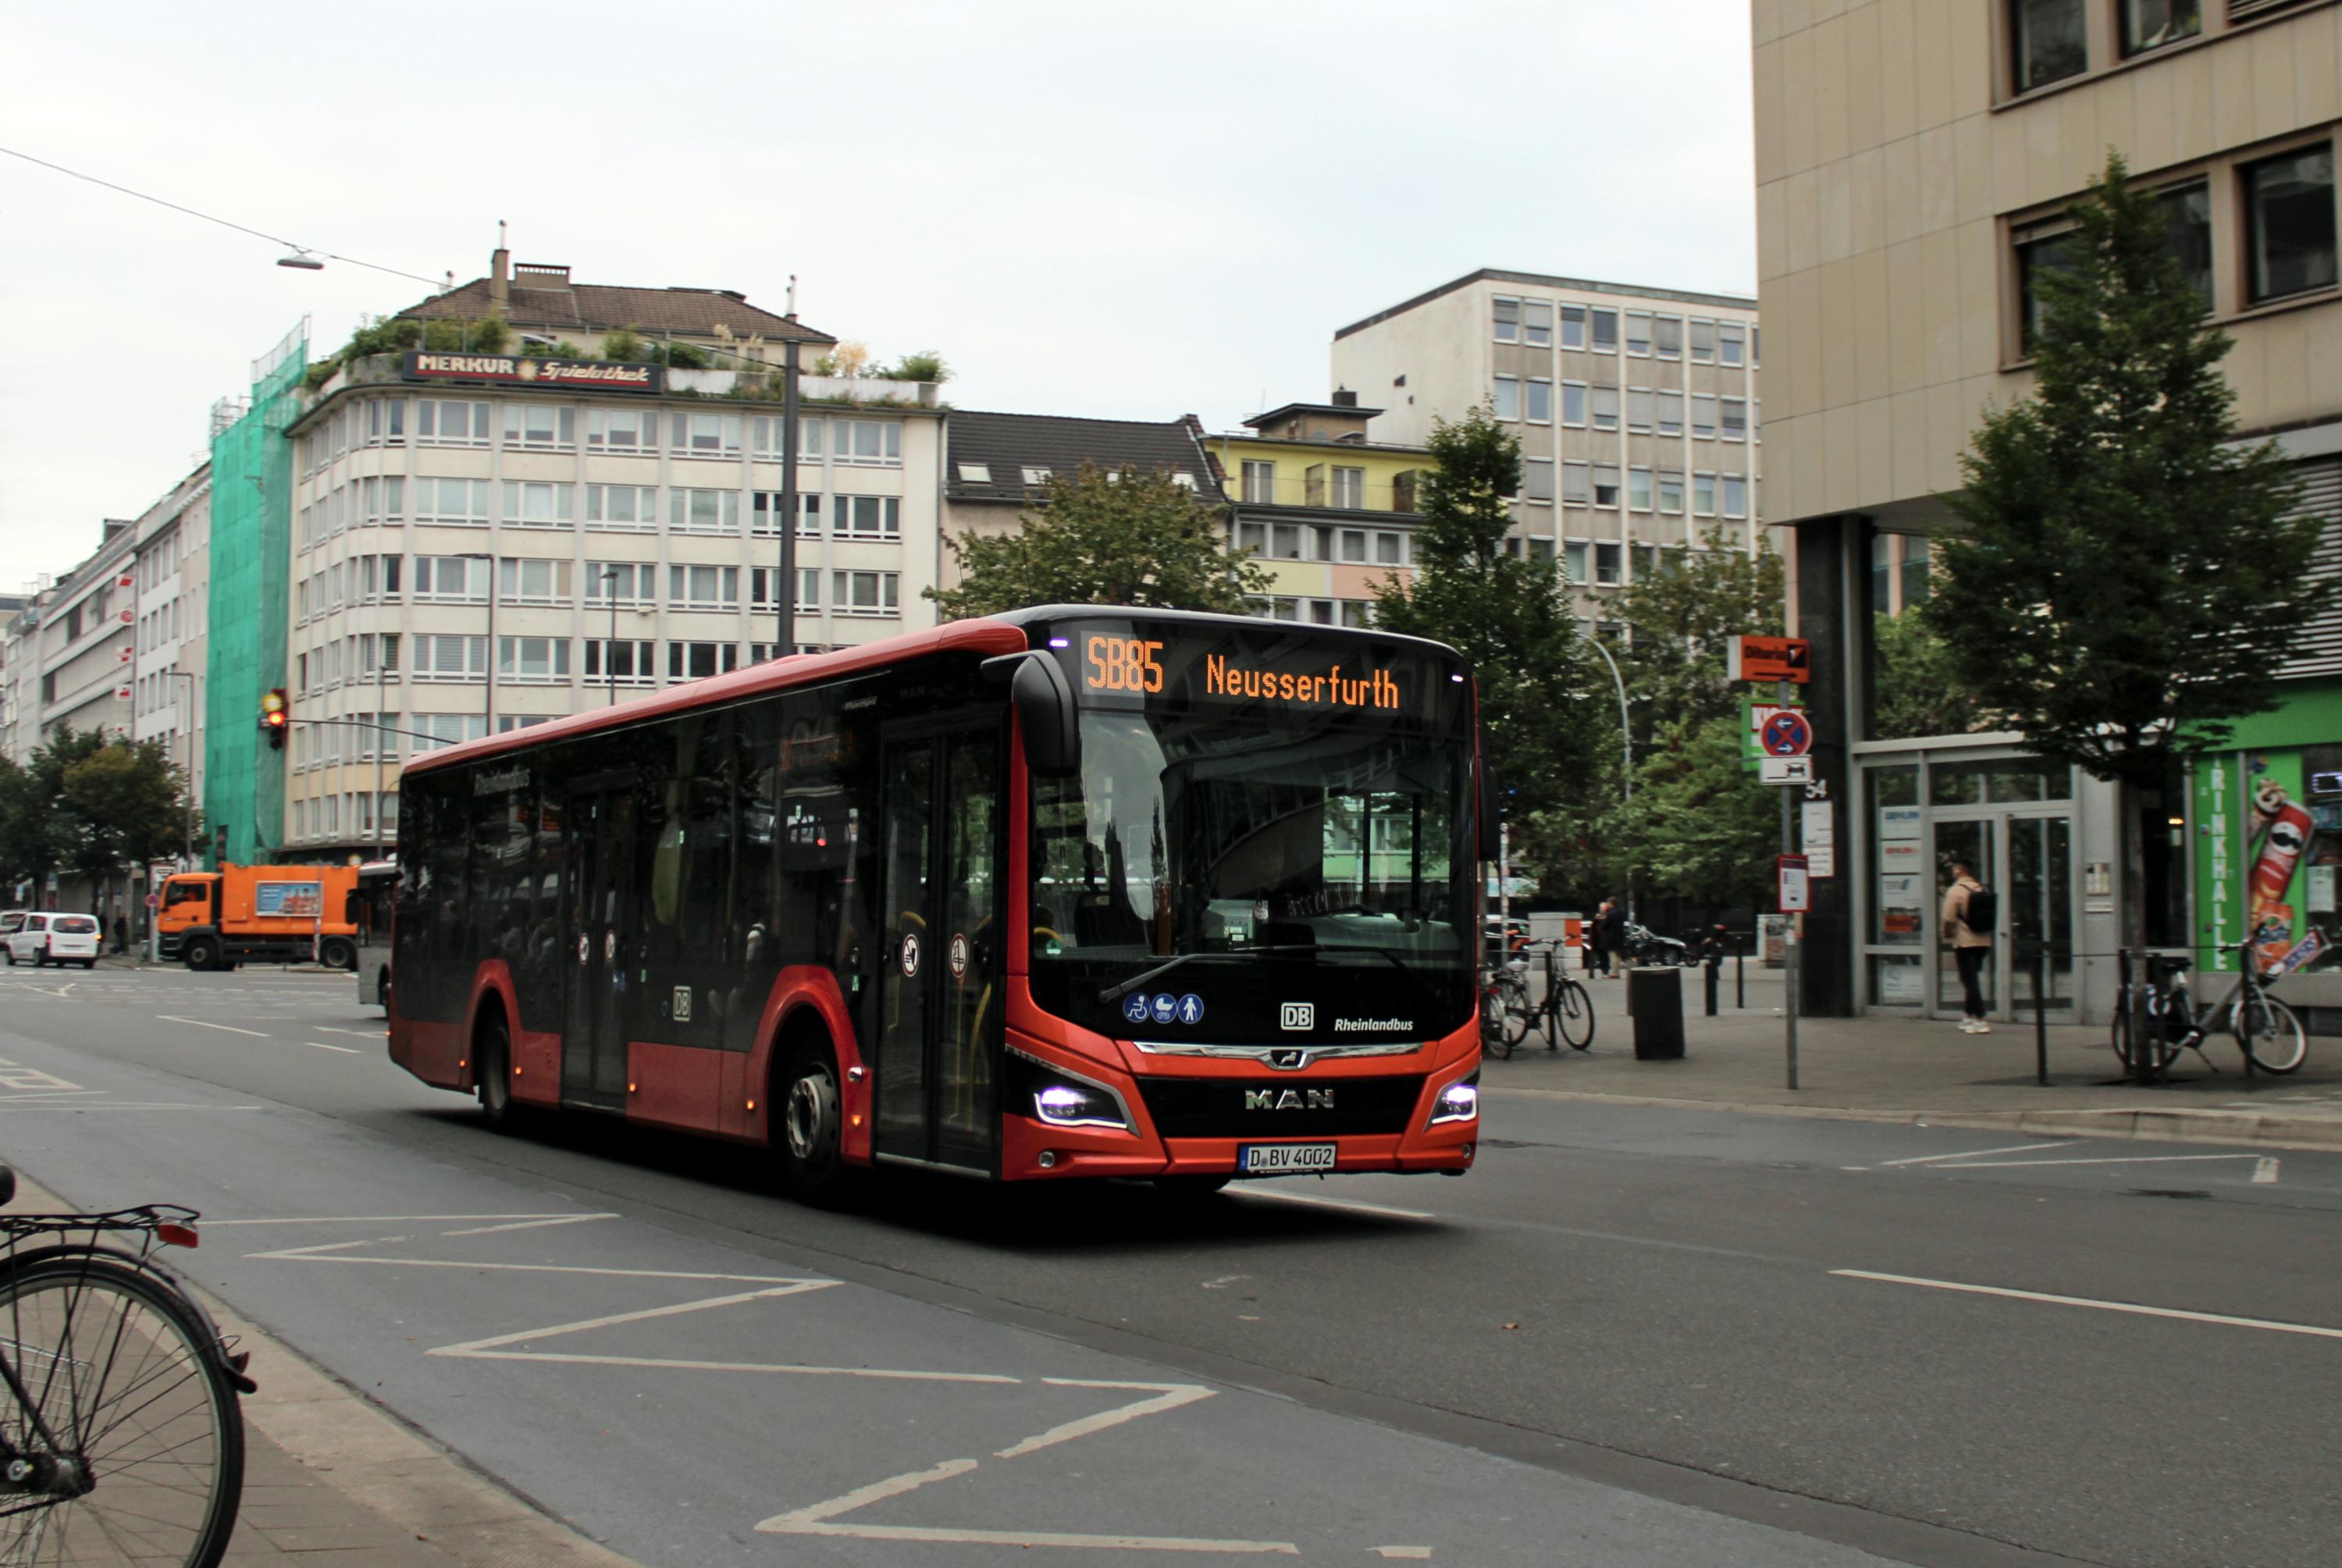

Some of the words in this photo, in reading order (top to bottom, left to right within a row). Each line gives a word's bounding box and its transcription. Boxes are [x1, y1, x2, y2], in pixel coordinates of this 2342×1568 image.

[418, 355, 514, 374] MERKUR
[539, 361, 649, 382] Spielothek
[1087, 636, 1163, 693] SB85
[1206, 653, 1399, 709] Neusserfurth
[1805, 779, 1827, 799] 54
[674, 990, 690, 1018] DB
[1283, 1005, 1312, 1028] DB
[1334, 1018, 1414, 1032] Rheinlandbus
[1244, 1089, 1333, 1110] MAN
[1250, 1150, 1260, 1167] D
[1269, 1149, 1290, 1166] BV
[1294, 1148, 1332, 1165] 4002
